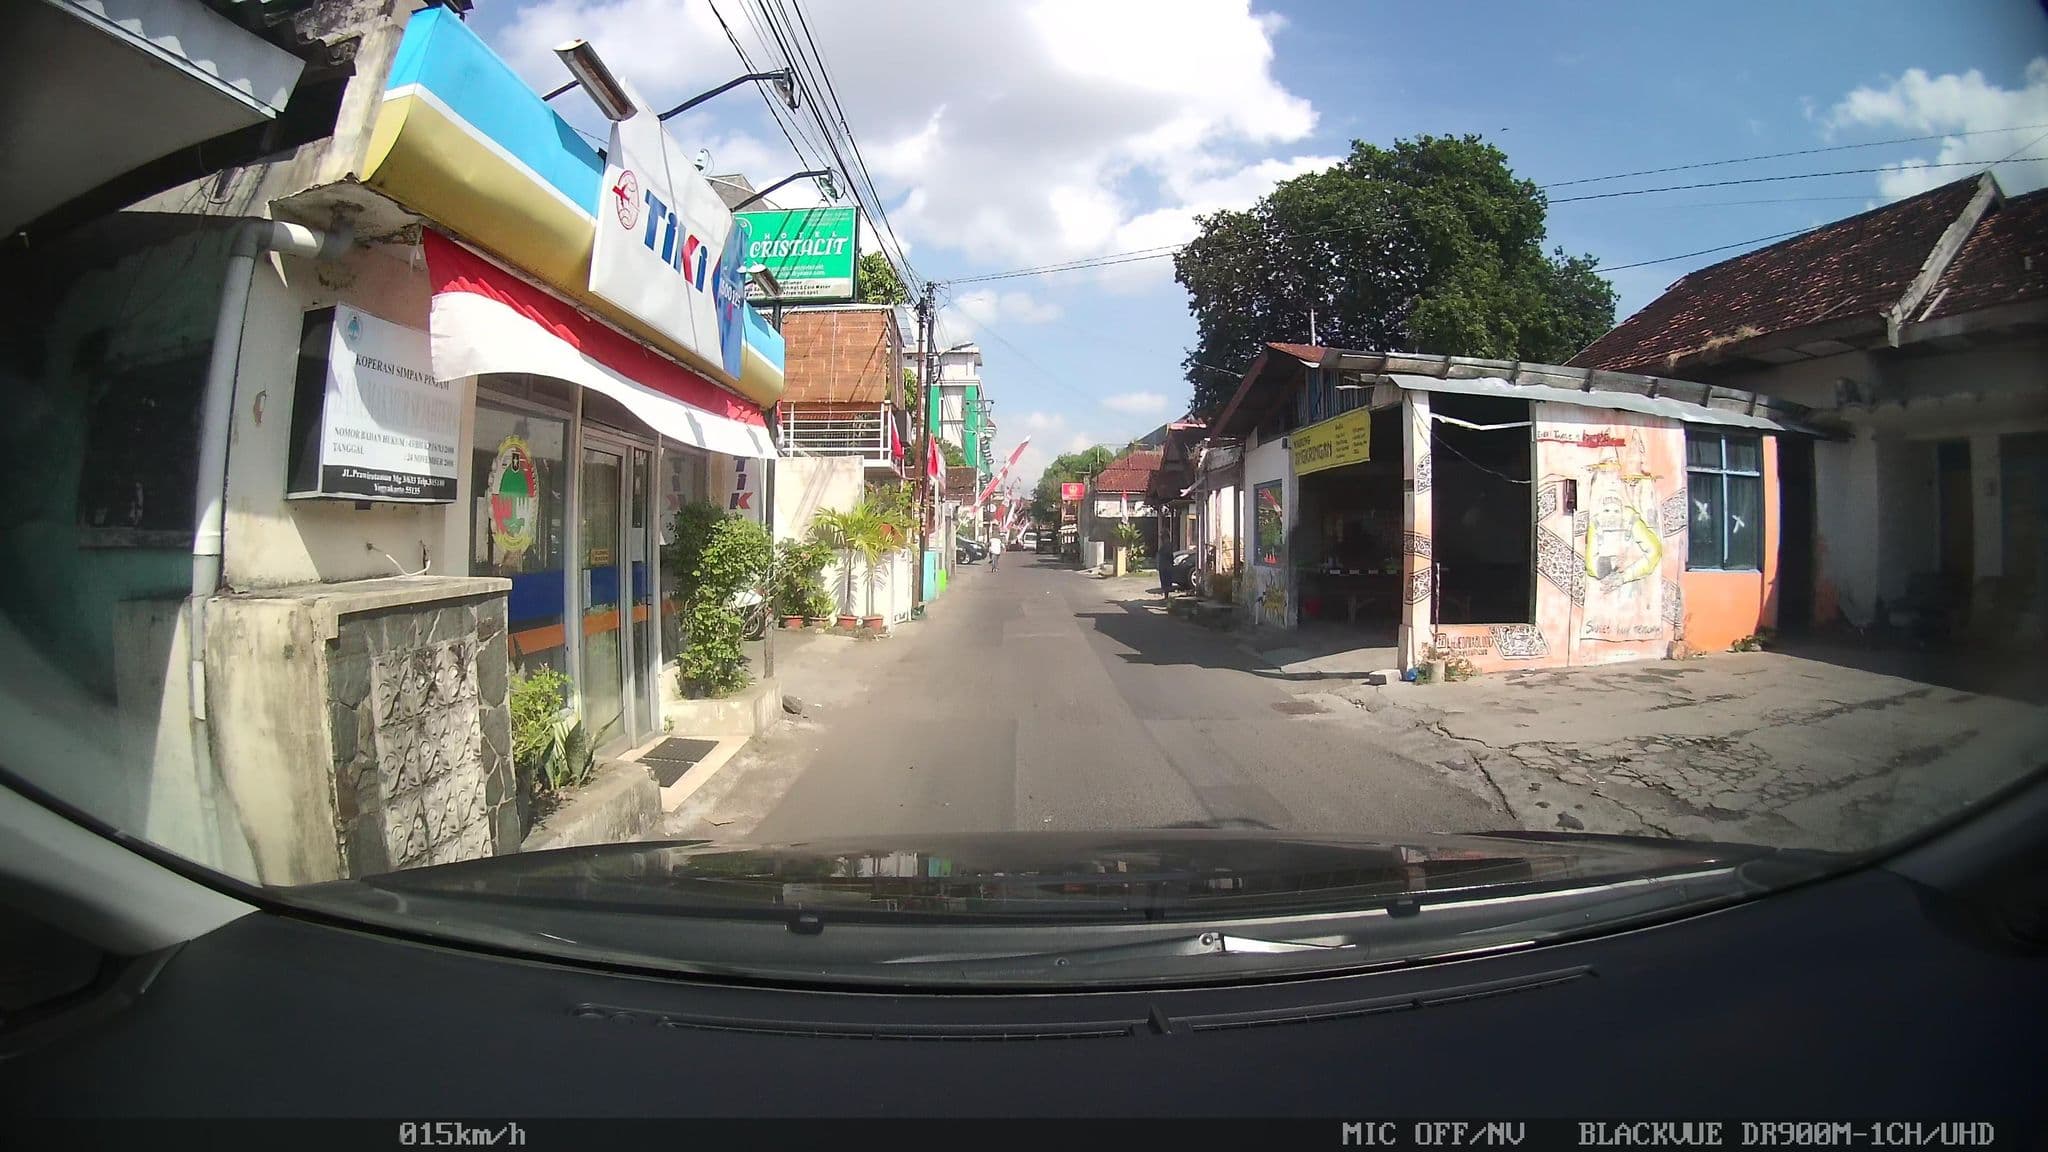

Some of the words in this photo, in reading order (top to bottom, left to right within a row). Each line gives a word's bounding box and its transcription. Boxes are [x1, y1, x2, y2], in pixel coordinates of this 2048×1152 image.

[749, 236, 849, 258] CRISTALIT
[355, 353, 395, 376] KOPERASI
[396, 366, 423, 382] SIMPAN
